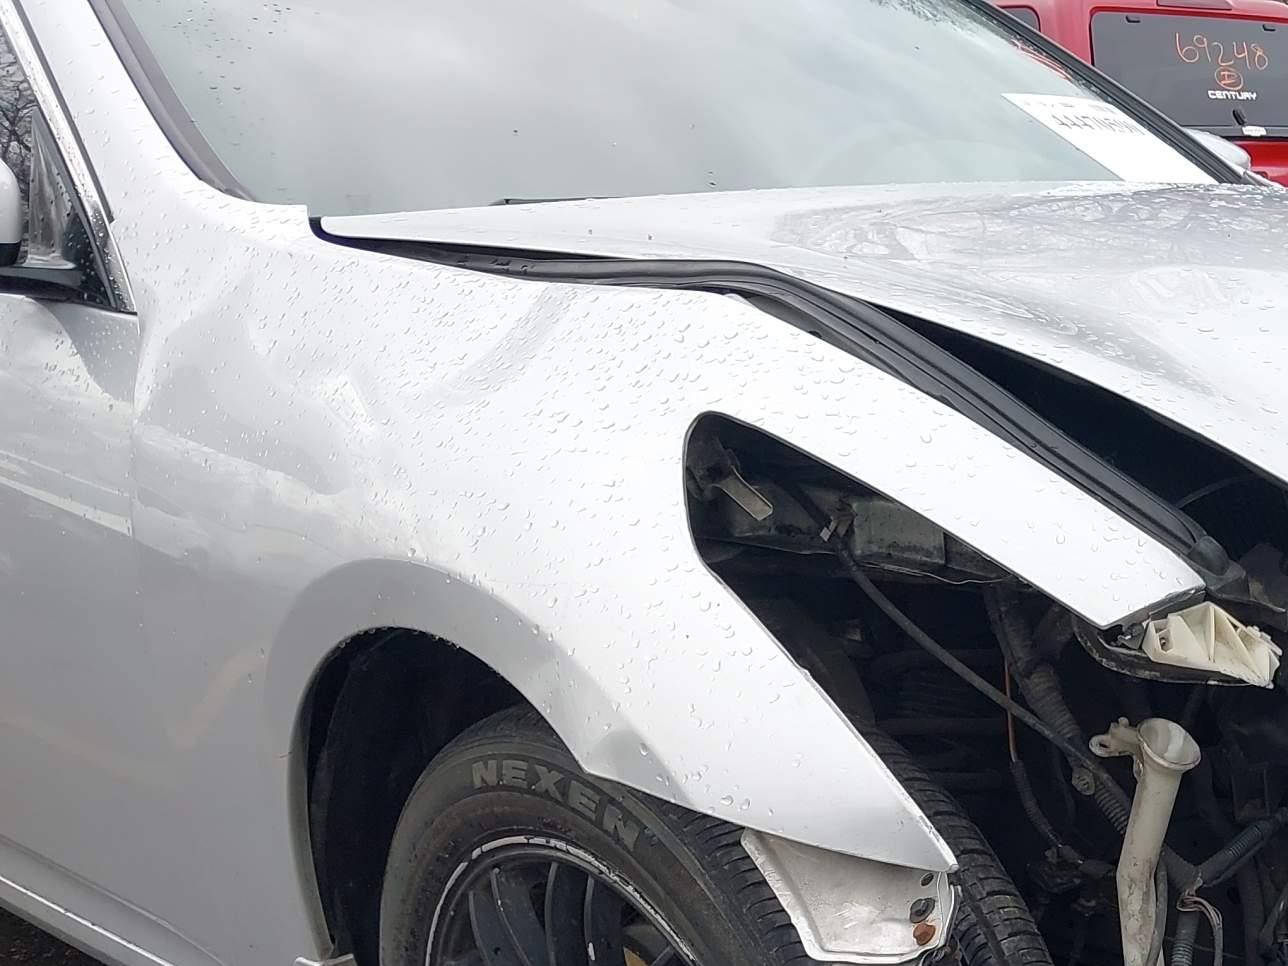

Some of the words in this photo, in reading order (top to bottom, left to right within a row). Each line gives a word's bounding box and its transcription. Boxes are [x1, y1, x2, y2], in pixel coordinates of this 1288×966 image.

[1175, 32, 1269, 70] 69248
[1207, 90, 1257, 100] CENTURY
[471, 758, 641, 851] NEXEN
